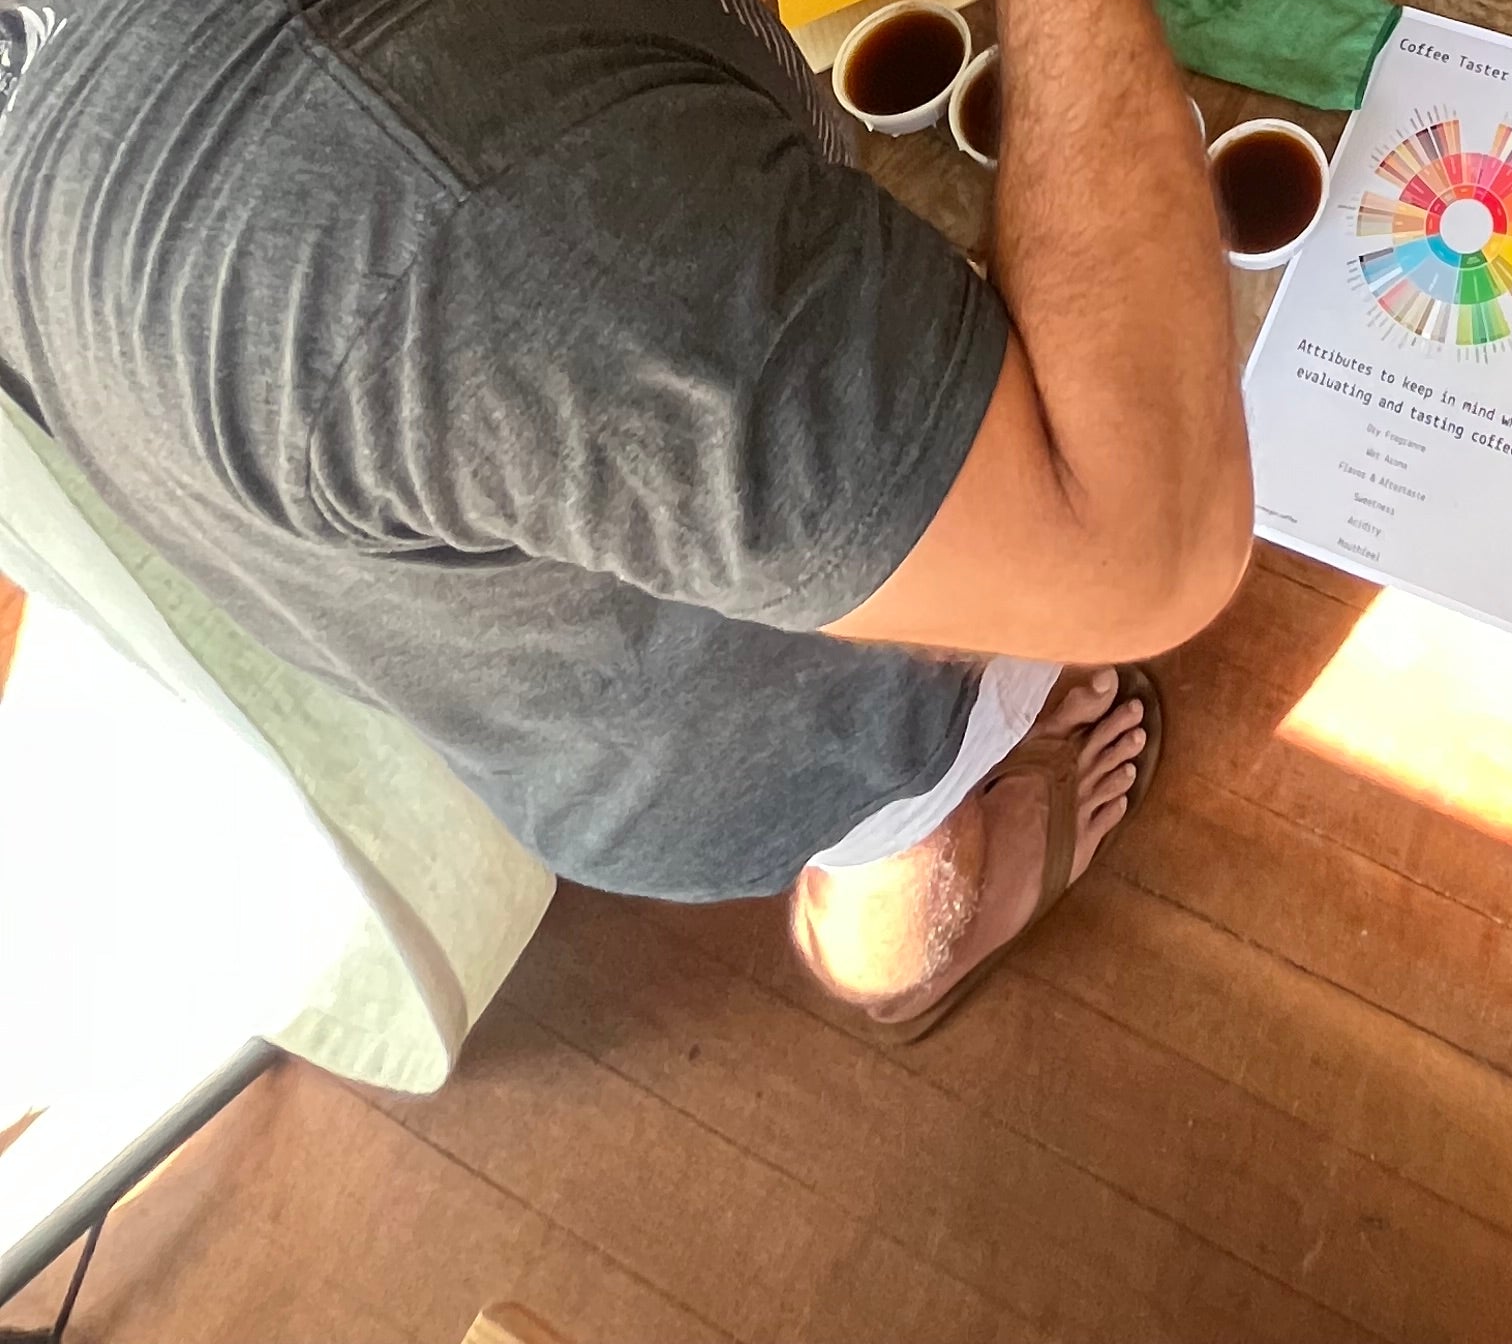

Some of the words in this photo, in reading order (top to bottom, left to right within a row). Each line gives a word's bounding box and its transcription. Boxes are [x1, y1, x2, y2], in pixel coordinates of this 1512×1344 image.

[1400, 38, 1450, 63] Coffee
[1297, 339, 1373, 375] Attributes
[1380, 369, 1395, 384] to
[1402, 376, 1433, 400] keep
[1440, 390, 1456, 406] in
[1462, 400, 1496, 421] mind
[1297, 367, 1373, 405] evaluating
[1379, 396, 1403, 414] and
[1410, 407, 1464, 439] tasting
[1338, 461, 1367, 479] Flavor
[1354, 492, 1395, 516] Sweetness
[1347, 516, 1382, 537] Acidity
[1337, 537, 1381, 562] Mouthfeel
